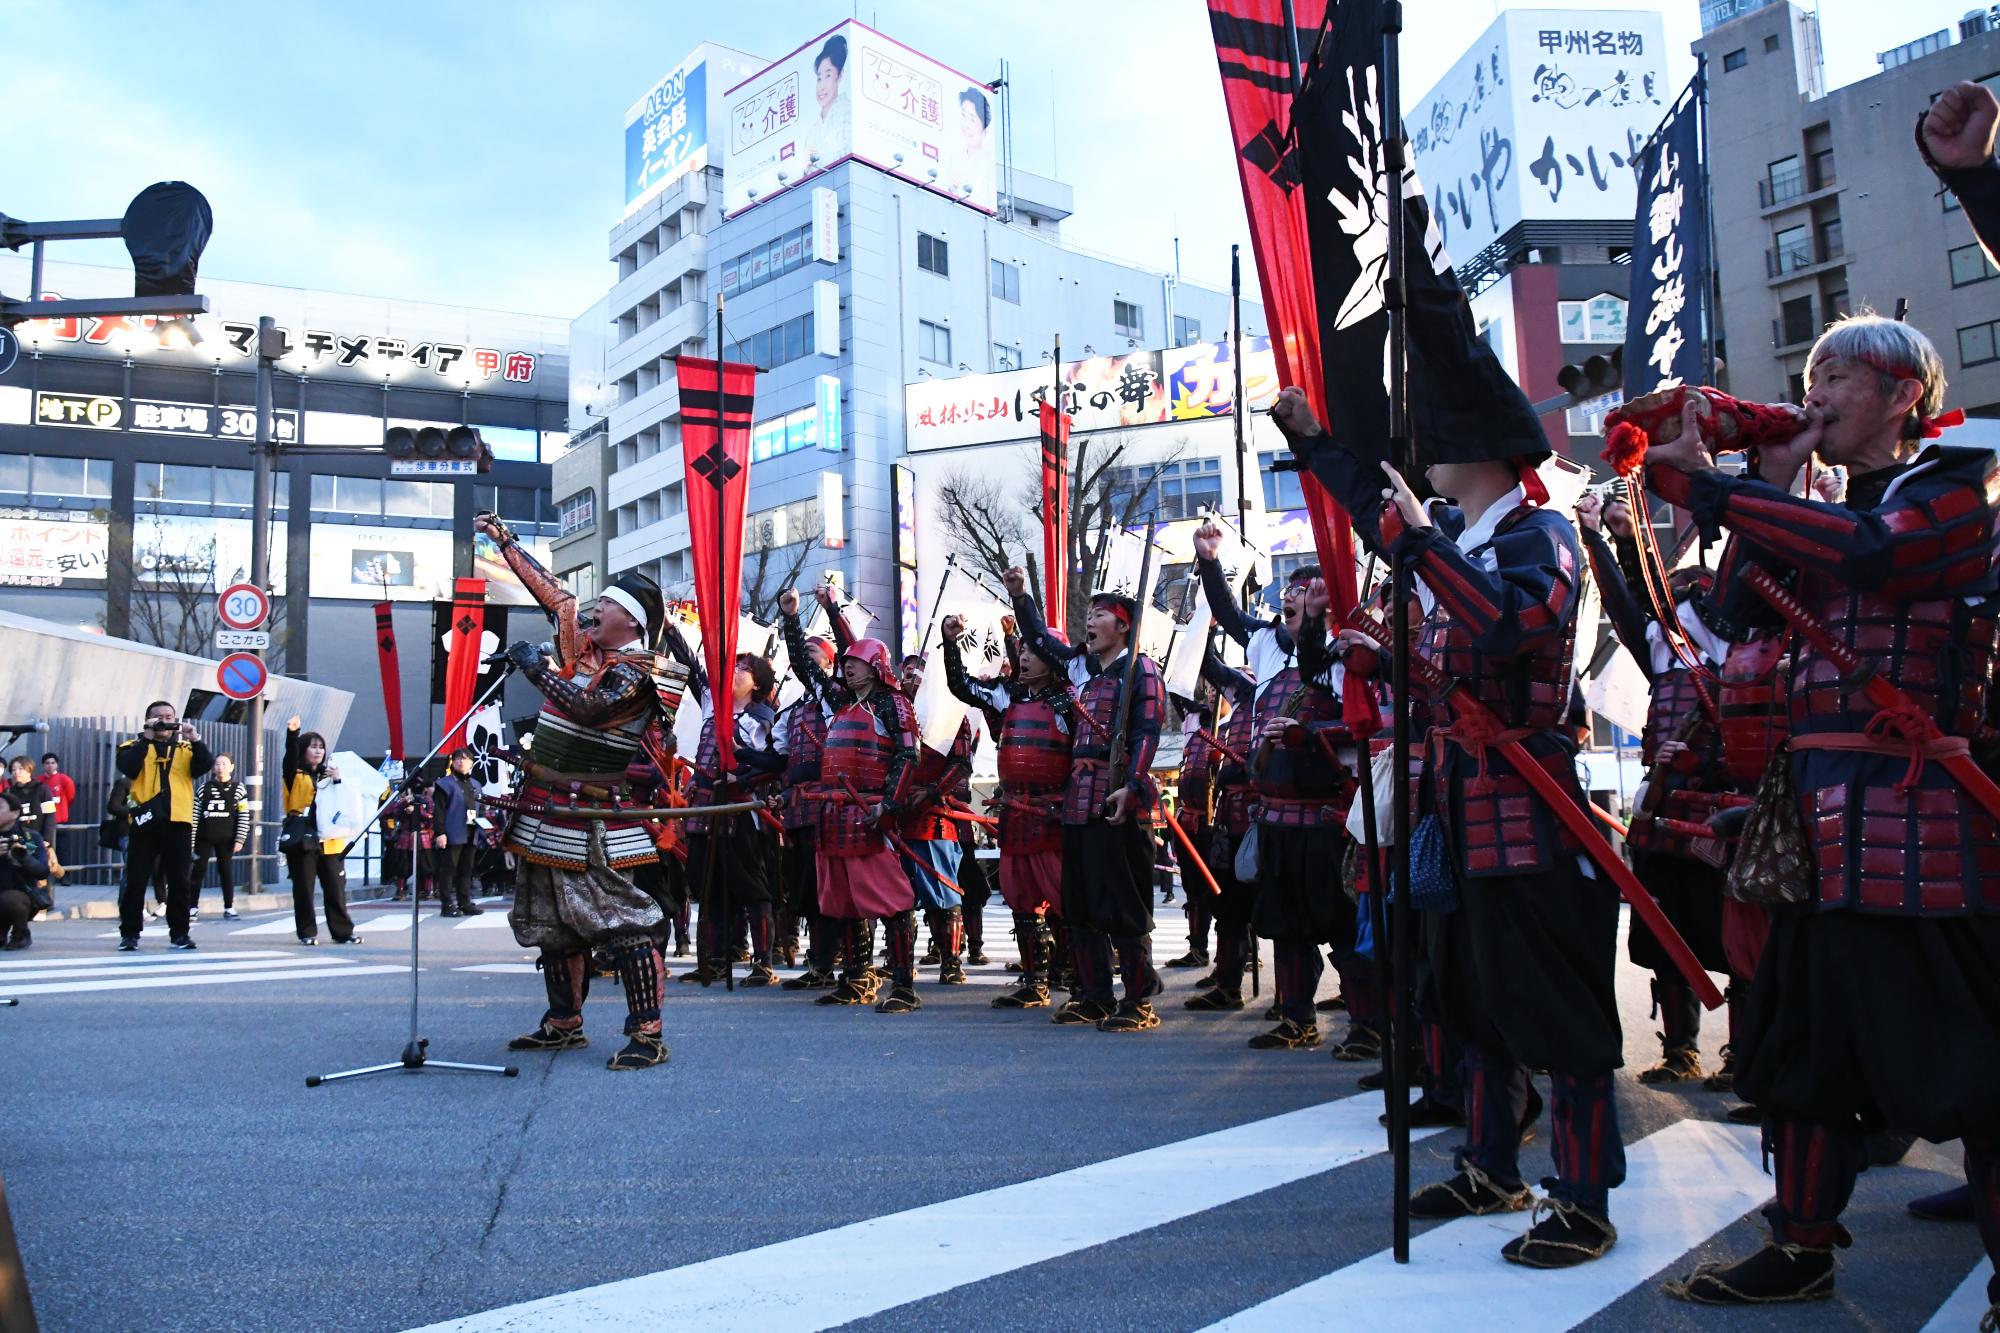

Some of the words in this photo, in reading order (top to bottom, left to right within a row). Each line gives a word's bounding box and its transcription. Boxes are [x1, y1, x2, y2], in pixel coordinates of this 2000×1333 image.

[1538, 30, 1643, 56] 甲州名物
[644, 69, 685, 124] AEON
[901, 88, 940, 126] 介護
[642, 97, 687, 159] 英会話
[762, 94, 796, 134] 介護
[637, 132, 692, 189] イーオン
[221, 411, 295, 438] 30台
[915, 397, 1008, 428] 風林火山
[416, 461, 473, 472] 歩車分離式
[230, 597, 257, 617] 30
[219, 634, 266, 646] ここから
